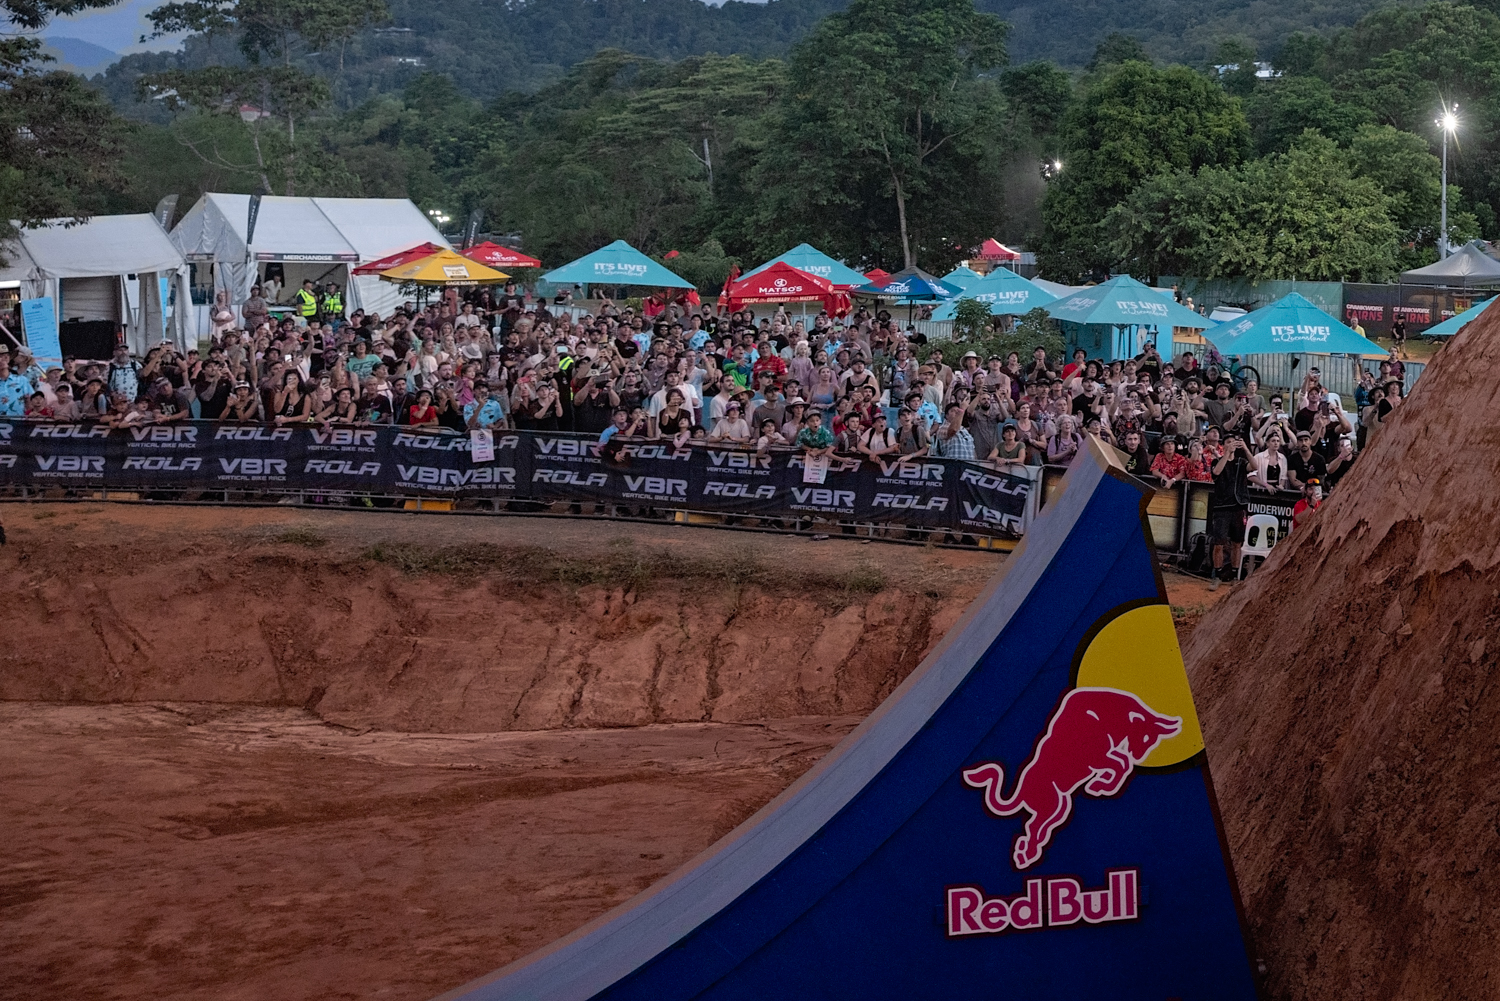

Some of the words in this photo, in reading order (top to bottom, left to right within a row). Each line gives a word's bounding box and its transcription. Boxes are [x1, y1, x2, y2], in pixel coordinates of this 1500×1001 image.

[602, 268, 644, 277] Queensland
[617, 263, 647, 272] LIVE!
[976, 292, 997, 302] IT'S
[999, 290, 1029, 299] LIVE!
[1116, 300, 1138, 309] IT'S
[1139, 301, 1168, 312] LIVE!
[1127, 307, 1168, 317] Queensland
[1346, 304, 1383, 312] CRANKWORX
[1346, 310, 1383, 321] CAIRNS
[1393, 312, 1430, 323] CIRNS
[1271, 325, 1295, 336] IT'S
[1297, 325, 1330, 336] LIVE!
[1280, 333, 1327, 342] Queensland
[30, 424, 111, 438] ROLA
[130, 426, 198, 442] VBR
[214, 426, 293, 441] ROLA
[309, 428, 377, 446] VBR
[393, 433, 448, 450] ROL
[534, 438, 601, 457] VBR
[535, 454, 566, 462] VERTICAL
[621, 444, 692, 461] ROLA
[707, 450, 772, 469] VBR
[34, 455, 106, 471] VBR
[122, 456, 202, 471] ROLA
[218, 458, 287, 475] VBR
[303, 460, 381, 476] ROLA
[787, 455, 862, 472] RLA
[880, 460, 945, 481] VBR
[532, 469, 608, 487] ROLA
[623, 475, 688, 496] VBR
[876, 478, 907, 486] VERTICAL
[622, 492, 653, 500] VERTICAL
[703, 481, 776, 499] ROLA
[791, 487, 856, 507] VBR
[790, 504, 820, 512] VERTICAL
[872, 493, 949, 511] ROLA
[948, 879, 1043, 936] Red
[1047, 869, 1138, 927] Bull
